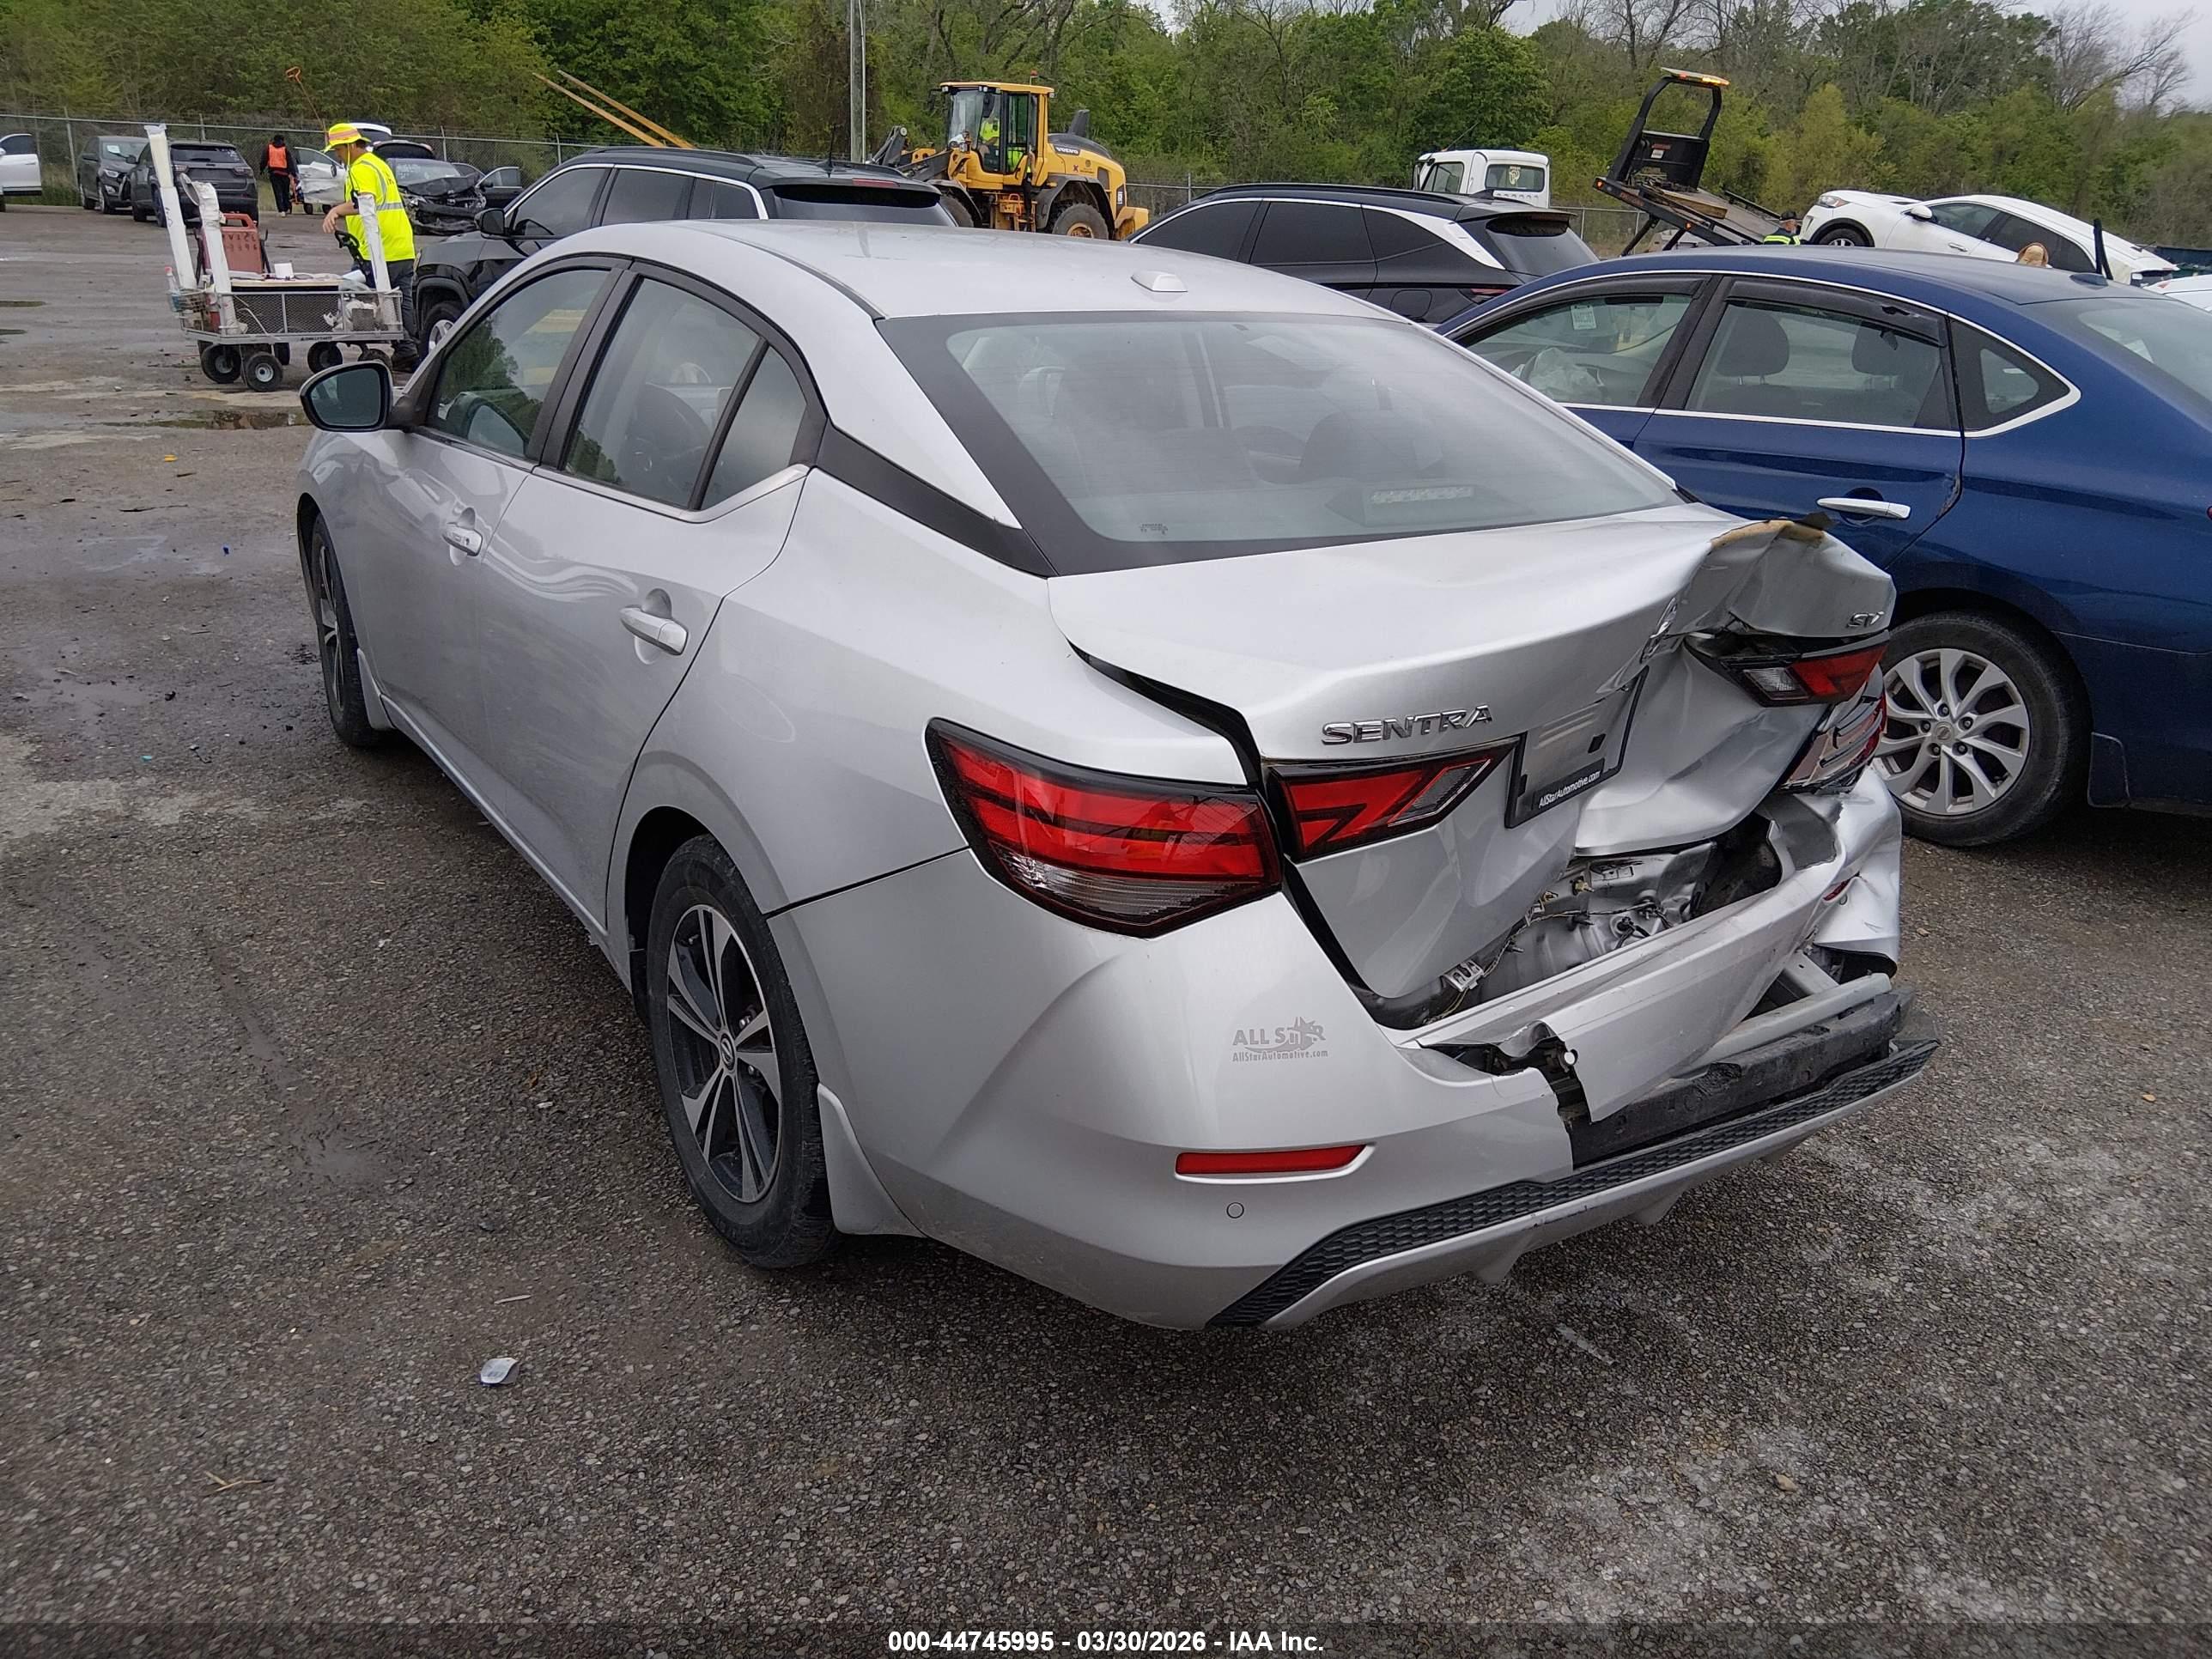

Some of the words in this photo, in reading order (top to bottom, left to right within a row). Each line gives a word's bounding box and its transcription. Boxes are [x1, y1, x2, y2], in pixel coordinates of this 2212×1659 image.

[1055, 146, 1079, 155] VOLVO
[1321, 703, 1493, 745] SENTRA
[1538, 769, 1601, 809] AllStarAutomotive.com
[1232, 1029, 1270, 1046] ALL
[1232, 1050, 1328, 1062] AllStarAutomotive.com
